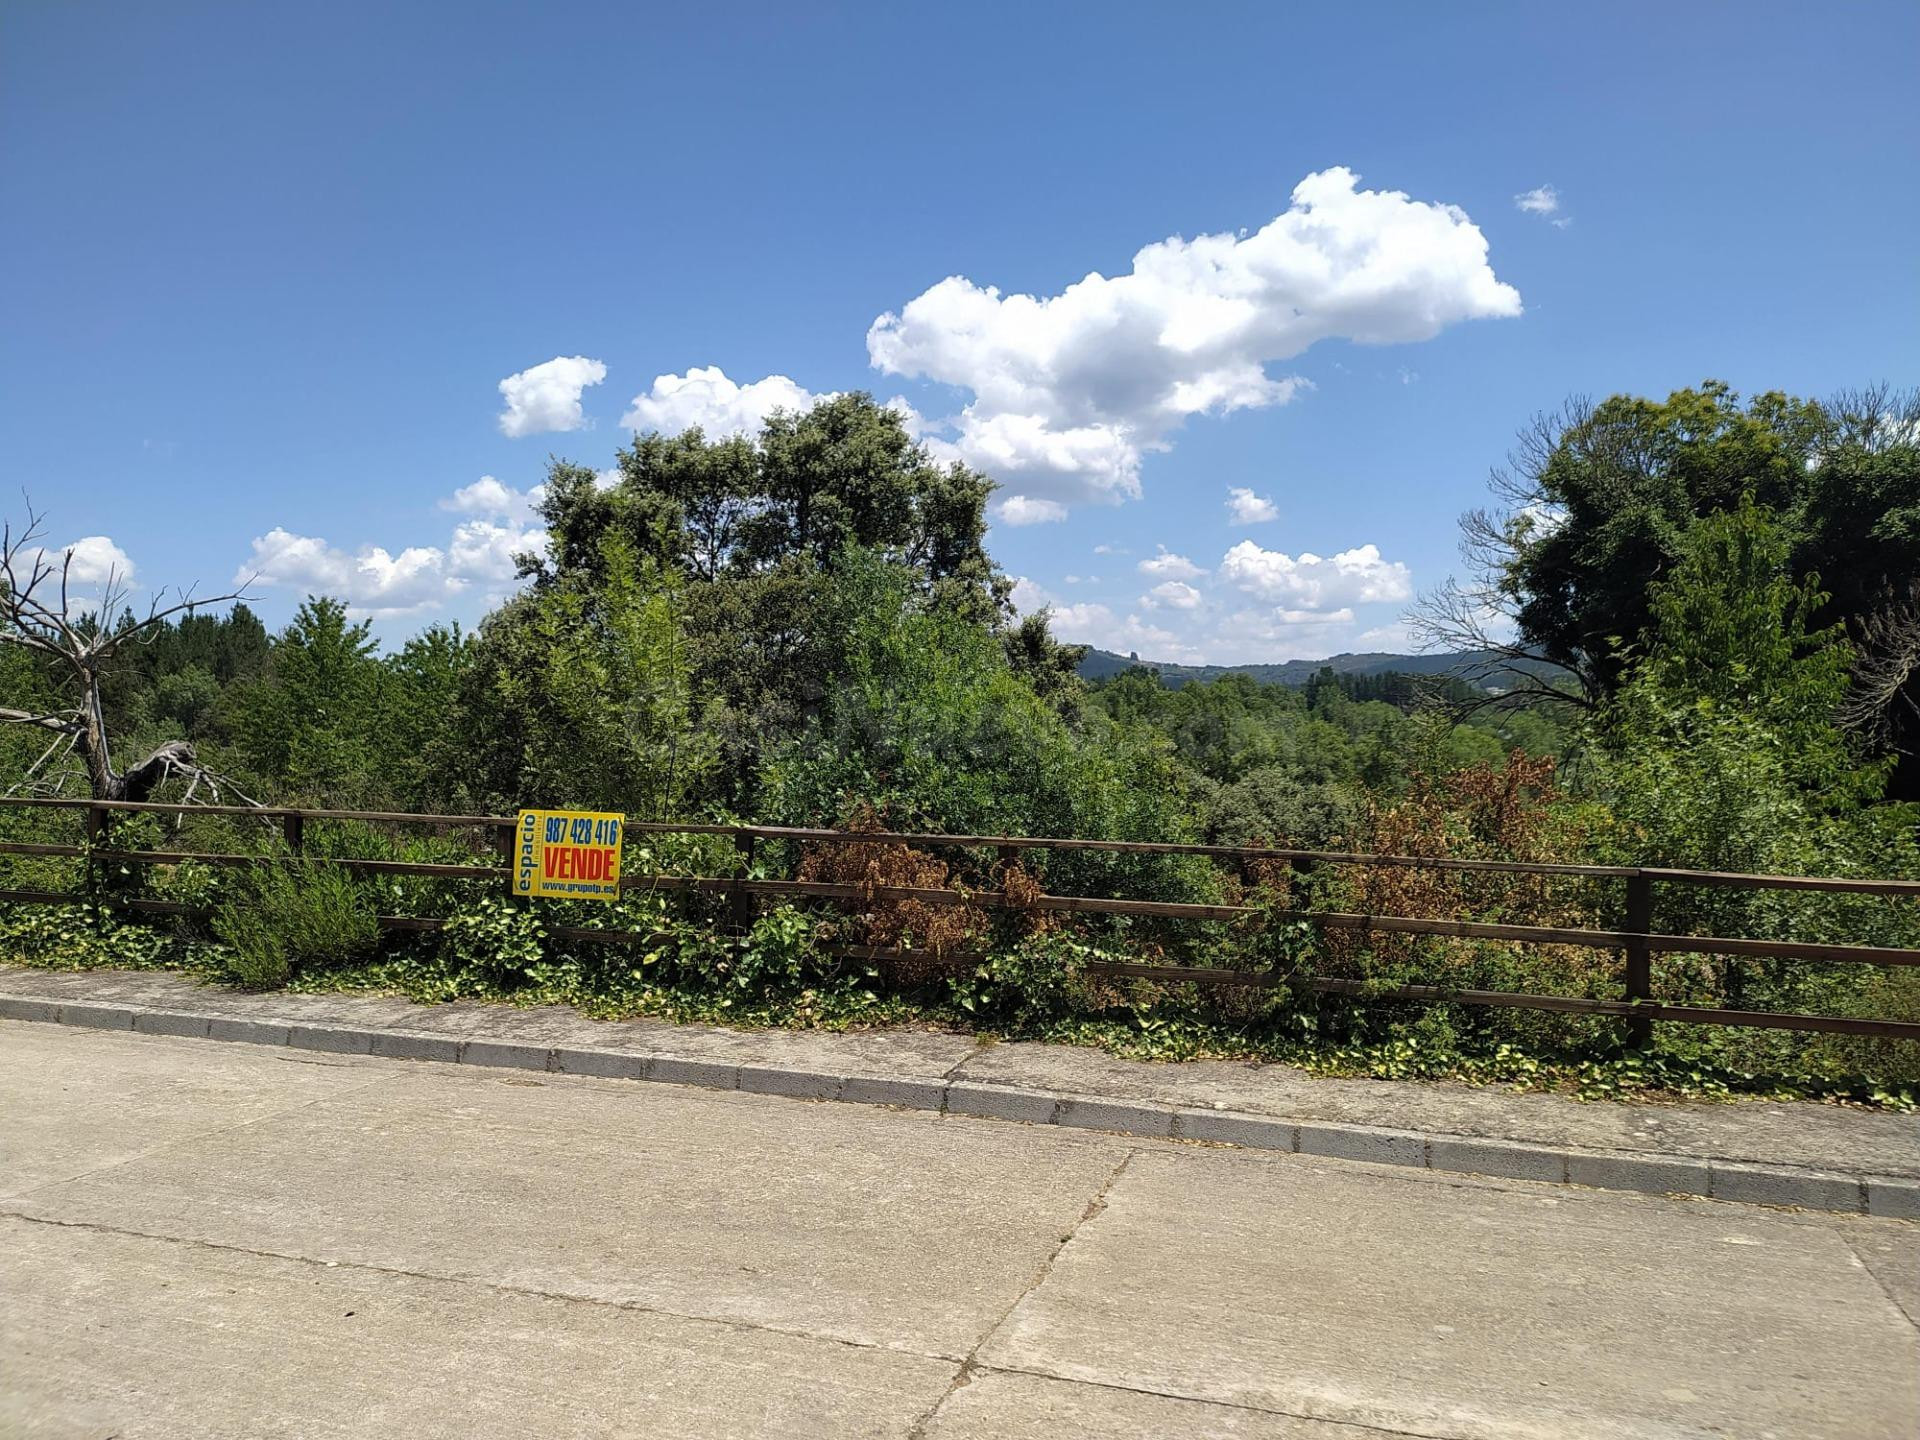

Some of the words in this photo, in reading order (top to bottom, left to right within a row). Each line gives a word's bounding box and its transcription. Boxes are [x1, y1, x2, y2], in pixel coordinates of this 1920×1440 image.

[545, 817, 568, 843] 987
[570, 818, 593, 845] 428
[595, 819, 618, 846] 416
[519, 814, 539, 891] espacio
[544, 847, 616, 881] VENDE
